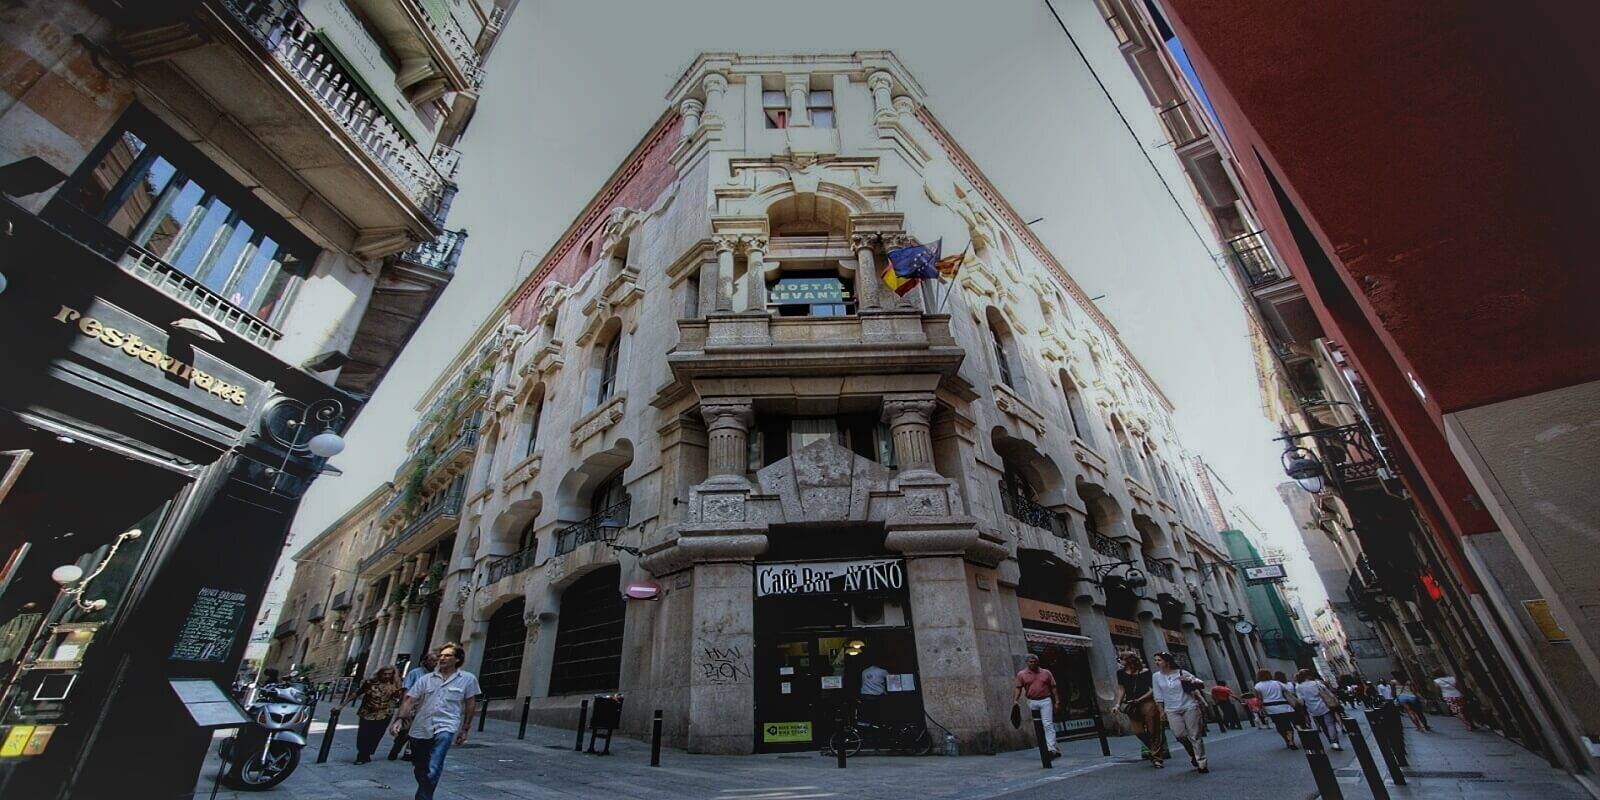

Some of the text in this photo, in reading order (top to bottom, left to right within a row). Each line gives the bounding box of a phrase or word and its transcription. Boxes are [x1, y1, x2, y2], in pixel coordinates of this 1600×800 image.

[770, 291, 851, 300] LEVANTE
[53, 305, 248, 406] restaurant
[802, 567, 834, 593] Bar
